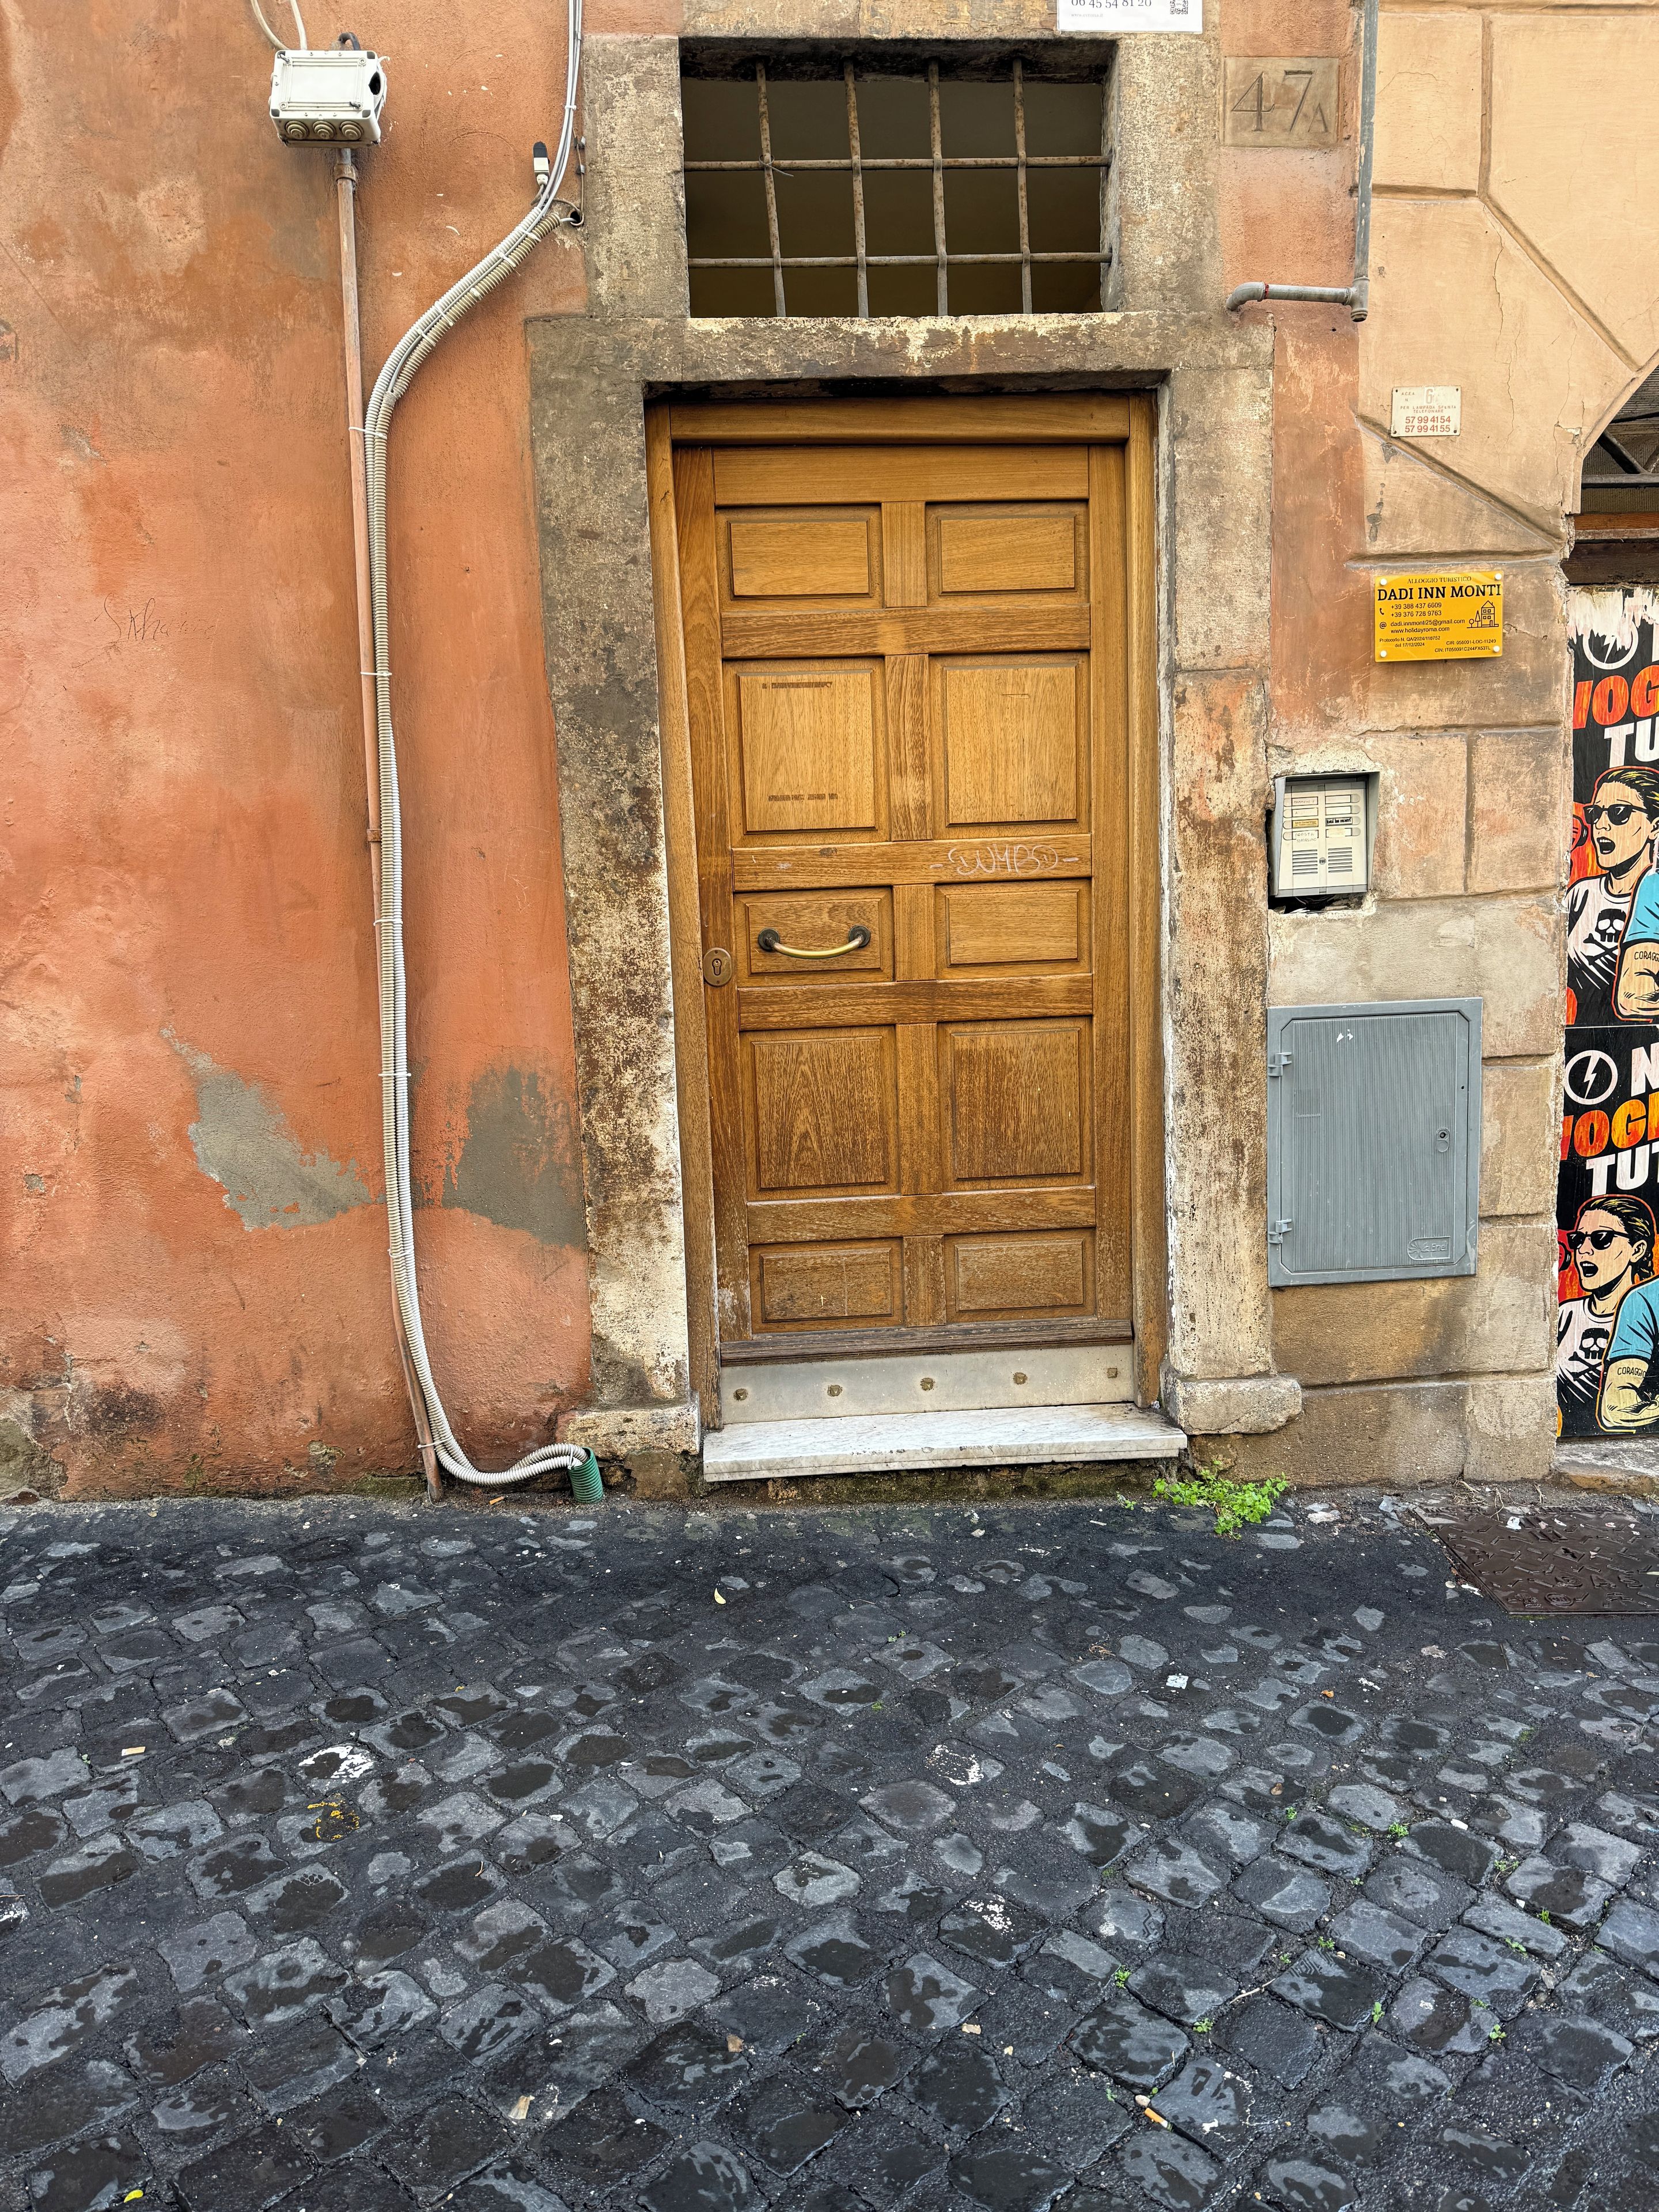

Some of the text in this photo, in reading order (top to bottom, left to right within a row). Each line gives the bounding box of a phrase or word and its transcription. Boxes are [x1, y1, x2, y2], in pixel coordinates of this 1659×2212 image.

[1089, 0, 1102, 9] 45
[1105, 0, 1119, 9] 54
[1405, 416, 1416, 424] 57
[1417, 416, 1429, 424] 99
[1404, 425, 1415, 433] 57
[1417, 425, 1428, 433] 99
[1377, 584, 1501, 601] DADI INN MONTI
[1391, 619, 1465, 627] dadi.innmonti25@gmail.com
[1634, 950, 1659, 962] CORAGG
[1617, 1366, 1646, 1378] CORAGGIO
